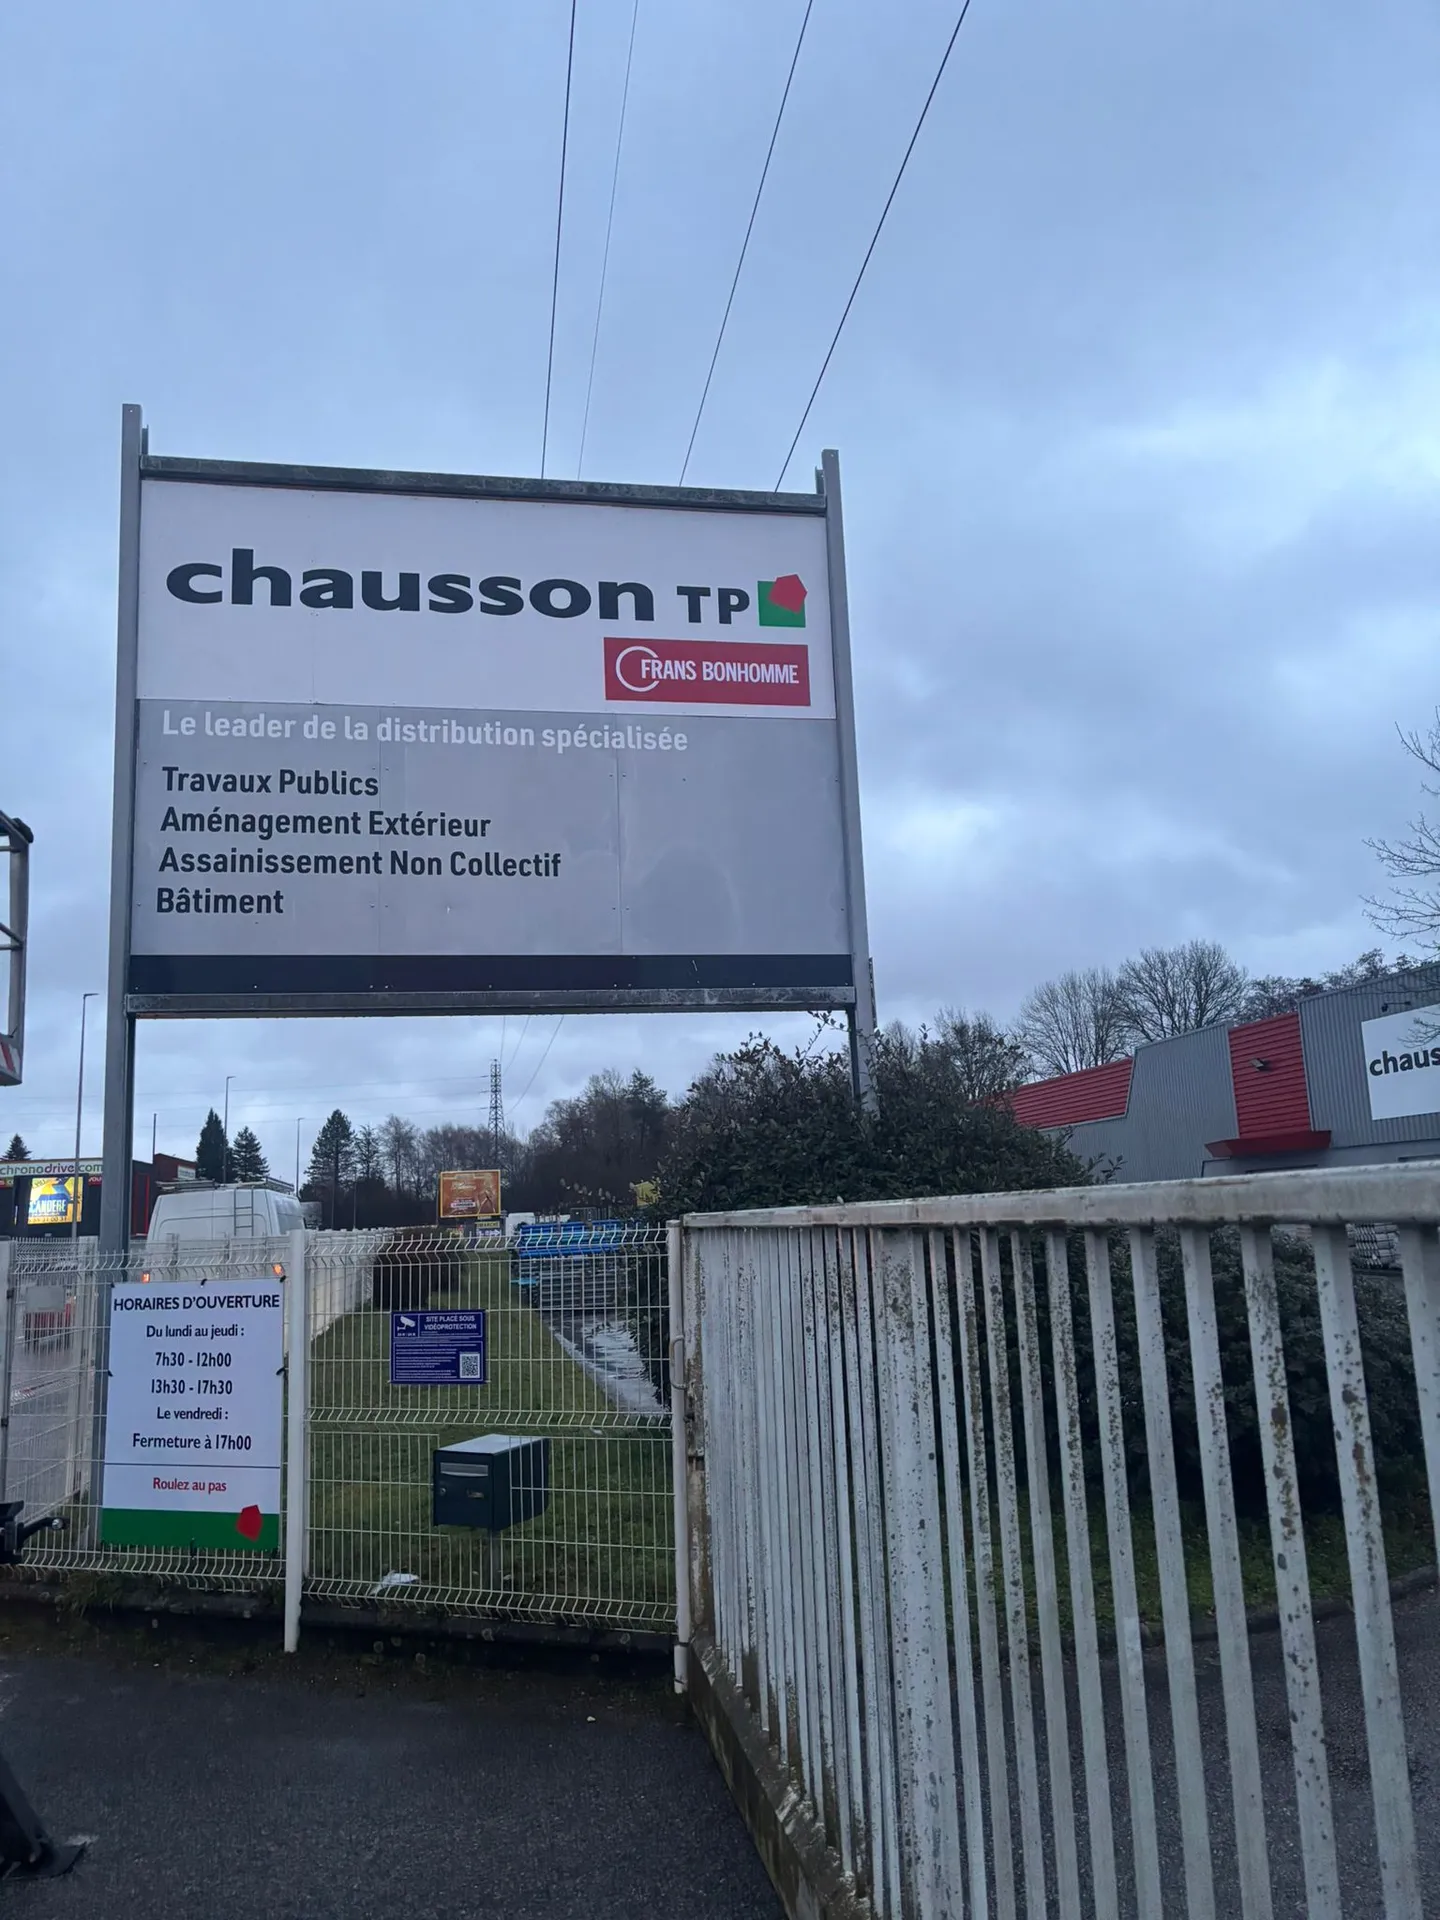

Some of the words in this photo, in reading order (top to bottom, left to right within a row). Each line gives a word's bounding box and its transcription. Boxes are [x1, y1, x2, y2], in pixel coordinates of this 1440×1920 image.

[166, 547, 654, 621] chausson
[676, 585, 750, 625] TP
[641, 658, 696, 681] FRANS
[702, 660, 799, 684] BONHOMME
[162, 709, 196, 736] Le
[204, 711, 296, 738] leader
[303, 714, 337, 740] de
[344, 716, 369, 741] la
[376, 717, 535, 746] distribution
[541, 722, 689, 754] spécialisée
[162, 766, 272, 793] Travaux
[279, 769, 379, 796] Publics
[160, 806, 361, 841] Aménagement
[369, 810, 492, 838] Extérieur
[158, 846, 383, 875] Assainissement
[390, 850, 443, 876] Non
[450, 850, 562, 878] Collectif
[156, 887, 284, 914] Bâtiment
[1369, 1047, 1440, 1077] chaus
[113, 1296, 180, 1311] HORAIRES
[146, 1325, 163, 1338] Du
[165, 1324, 192, 1338] lundi
[195, 1328, 209, 1337] au
[211, 1323, 239, 1340] jeudi
[155, 1351, 185, 1367] 7h30
[196, 1352, 232, 1367] 12h00
[151, 1379, 186, 1394] 13h30
[197, 1379, 233, 1395] 17h30
[156, 1406, 171, 1420] Le
[173, 1407, 223, 1420] vendredi
[132, 1432, 201, 1449] Fermeture
[204, 1434, 212, 1449] à
[216, 1434, 252, 1451] 17h00
[153, 1477, 189, 1490] Roulez
[192, 1481, 205, 1491] au
[208, 1482, 227, 1494] pas
